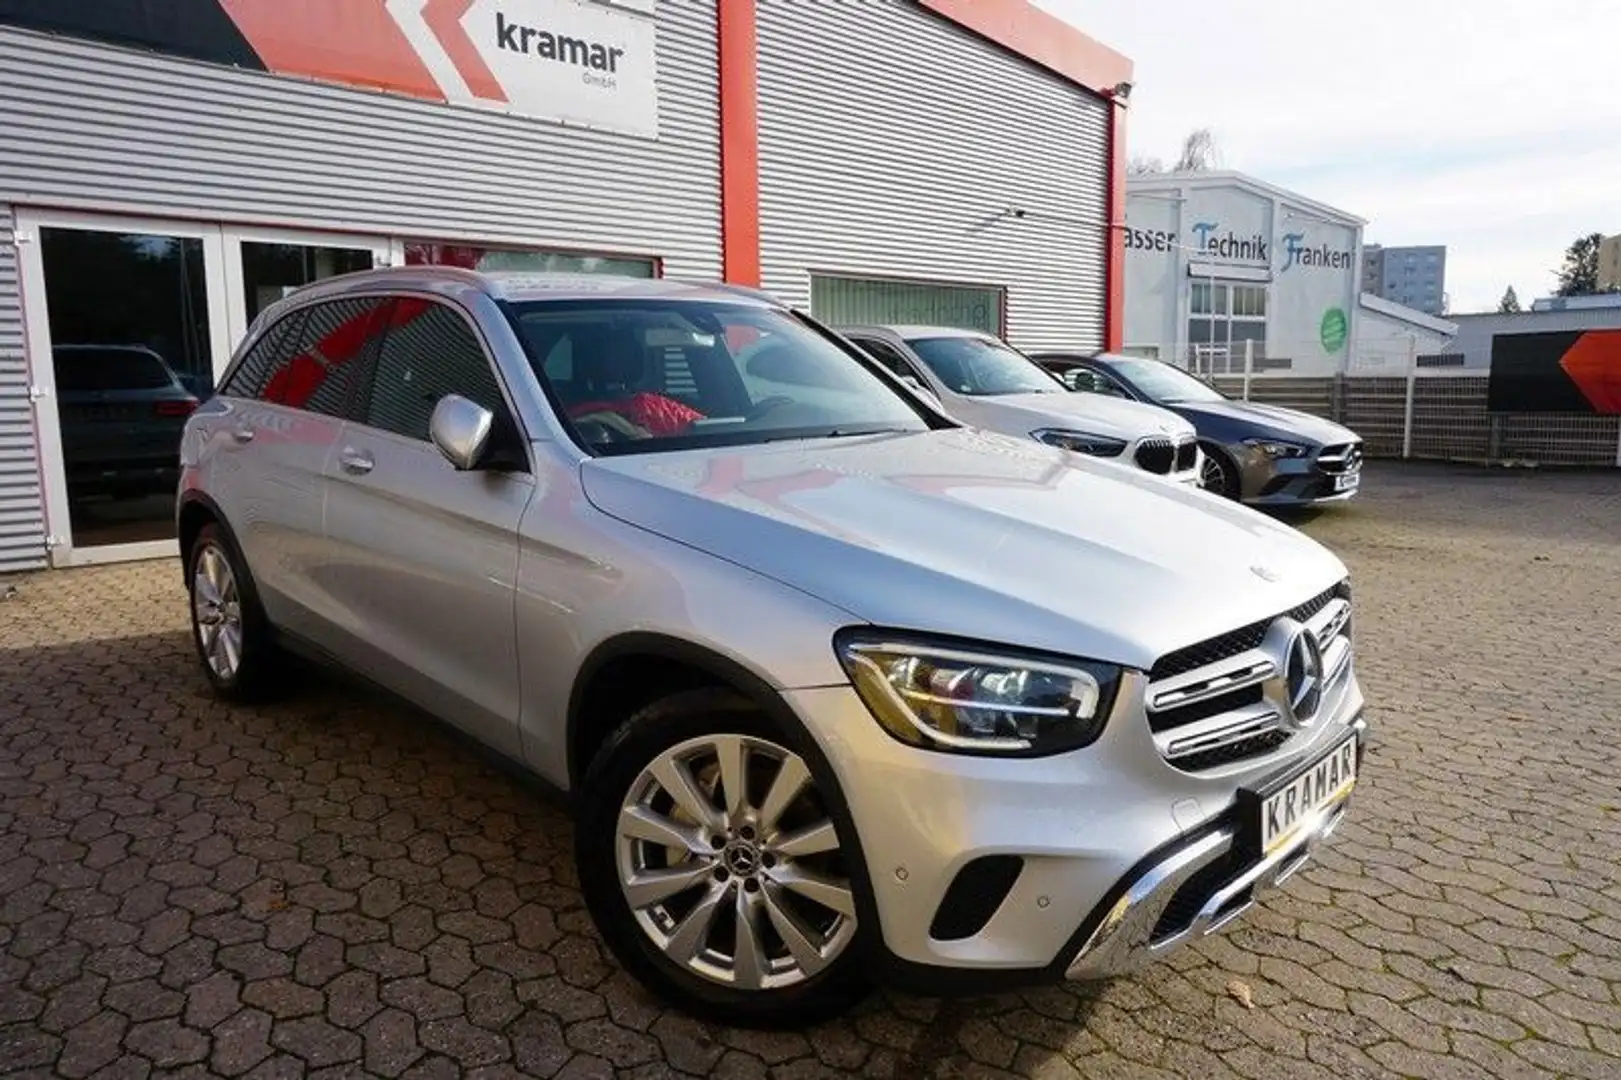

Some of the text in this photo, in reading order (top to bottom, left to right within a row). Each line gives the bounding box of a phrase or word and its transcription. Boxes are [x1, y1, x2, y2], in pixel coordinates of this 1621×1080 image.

[496, 12, 624, 73] kramar
[1124, 222, 1350, 272] asser Technik Franken
[1267, 744, 1351, 841] KRAMAR
